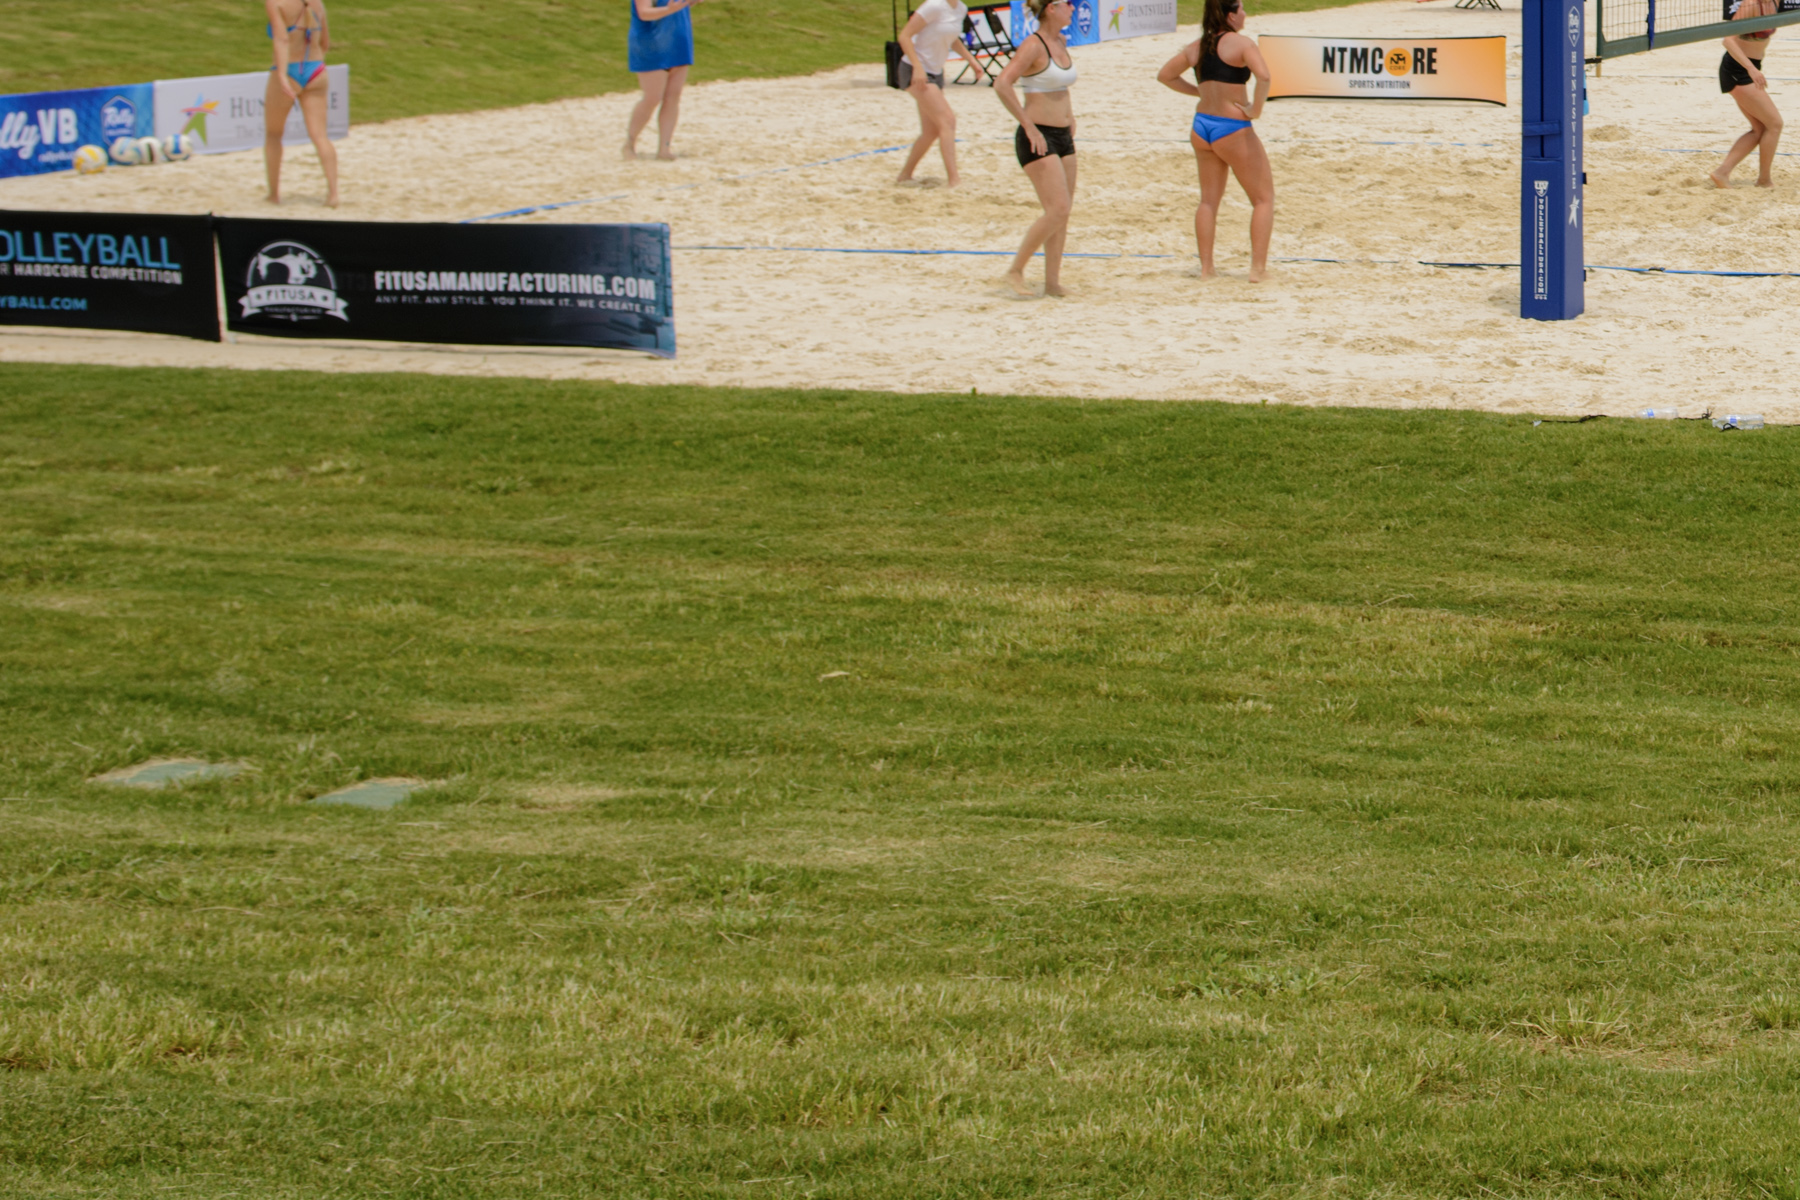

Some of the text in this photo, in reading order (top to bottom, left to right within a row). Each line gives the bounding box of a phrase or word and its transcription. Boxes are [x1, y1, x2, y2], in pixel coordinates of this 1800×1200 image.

[1128, 2, 1173, 18] HUNTSVILLE
[1349, 80, 1411, 89] SPORTS NUTRITION
[14, 263, 88, 278] HARDCORE
[91, 266, 183, 285] COMPETITION
[374, 271, 656, 300] FITUSAMANUFACTURING.COM
[266, 290, 317, 301] FITUSA
[375, 295, 397, 304] ANY
[425, 295, 447, 304] ANY
[492, 297, 516, 306] YOU
[520, 298, 555, 307] THINK
[578, 299, 595, 309] WE
[599, 301, 642, 313] CREATE
